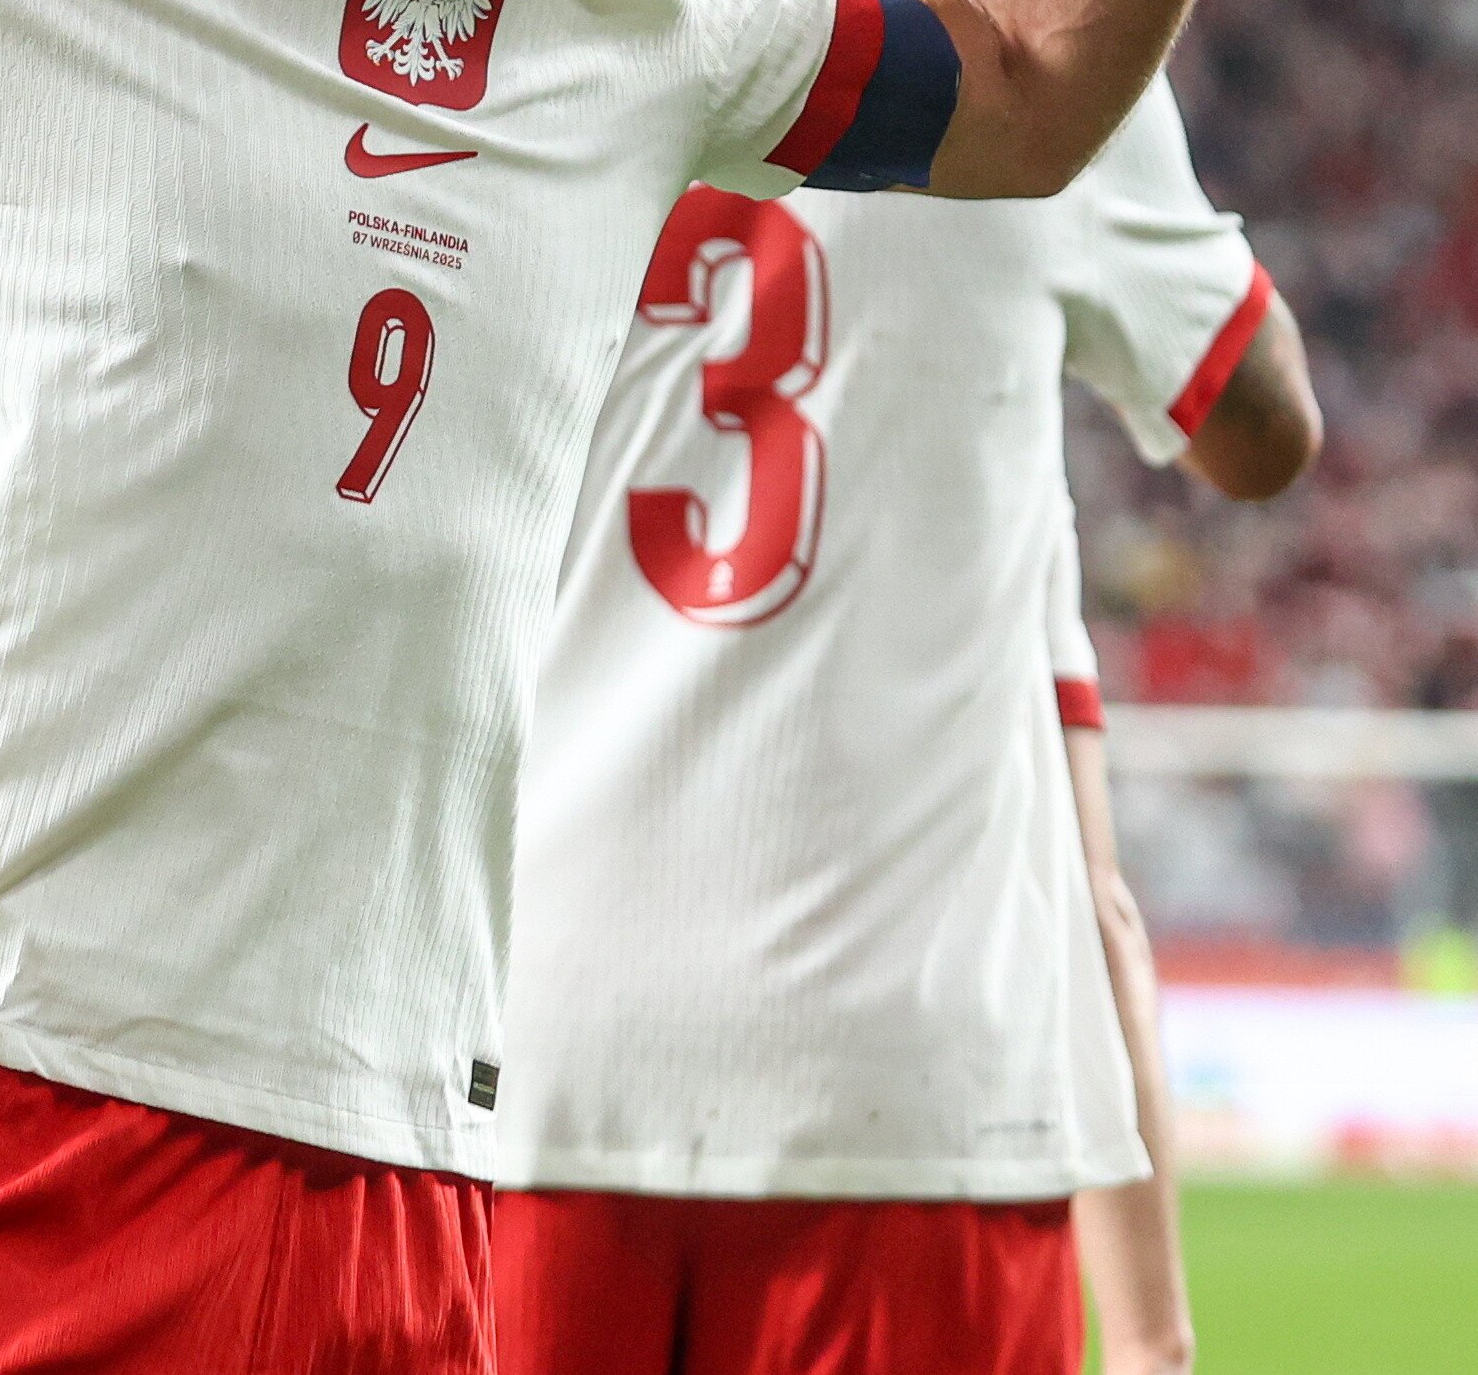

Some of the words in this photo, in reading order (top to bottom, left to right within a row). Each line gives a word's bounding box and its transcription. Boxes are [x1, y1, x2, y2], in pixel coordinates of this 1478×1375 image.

[348, 210, 469, 253] POLSKA-FINLANDIA
[352, 230, 368, 245] 07
[370, 234, 430, 262] WRZEŚNIA
[432, 251, 463, 270] 2025
[336, 288, 435, 504] 9
[628, 182, 831, 629] 3
